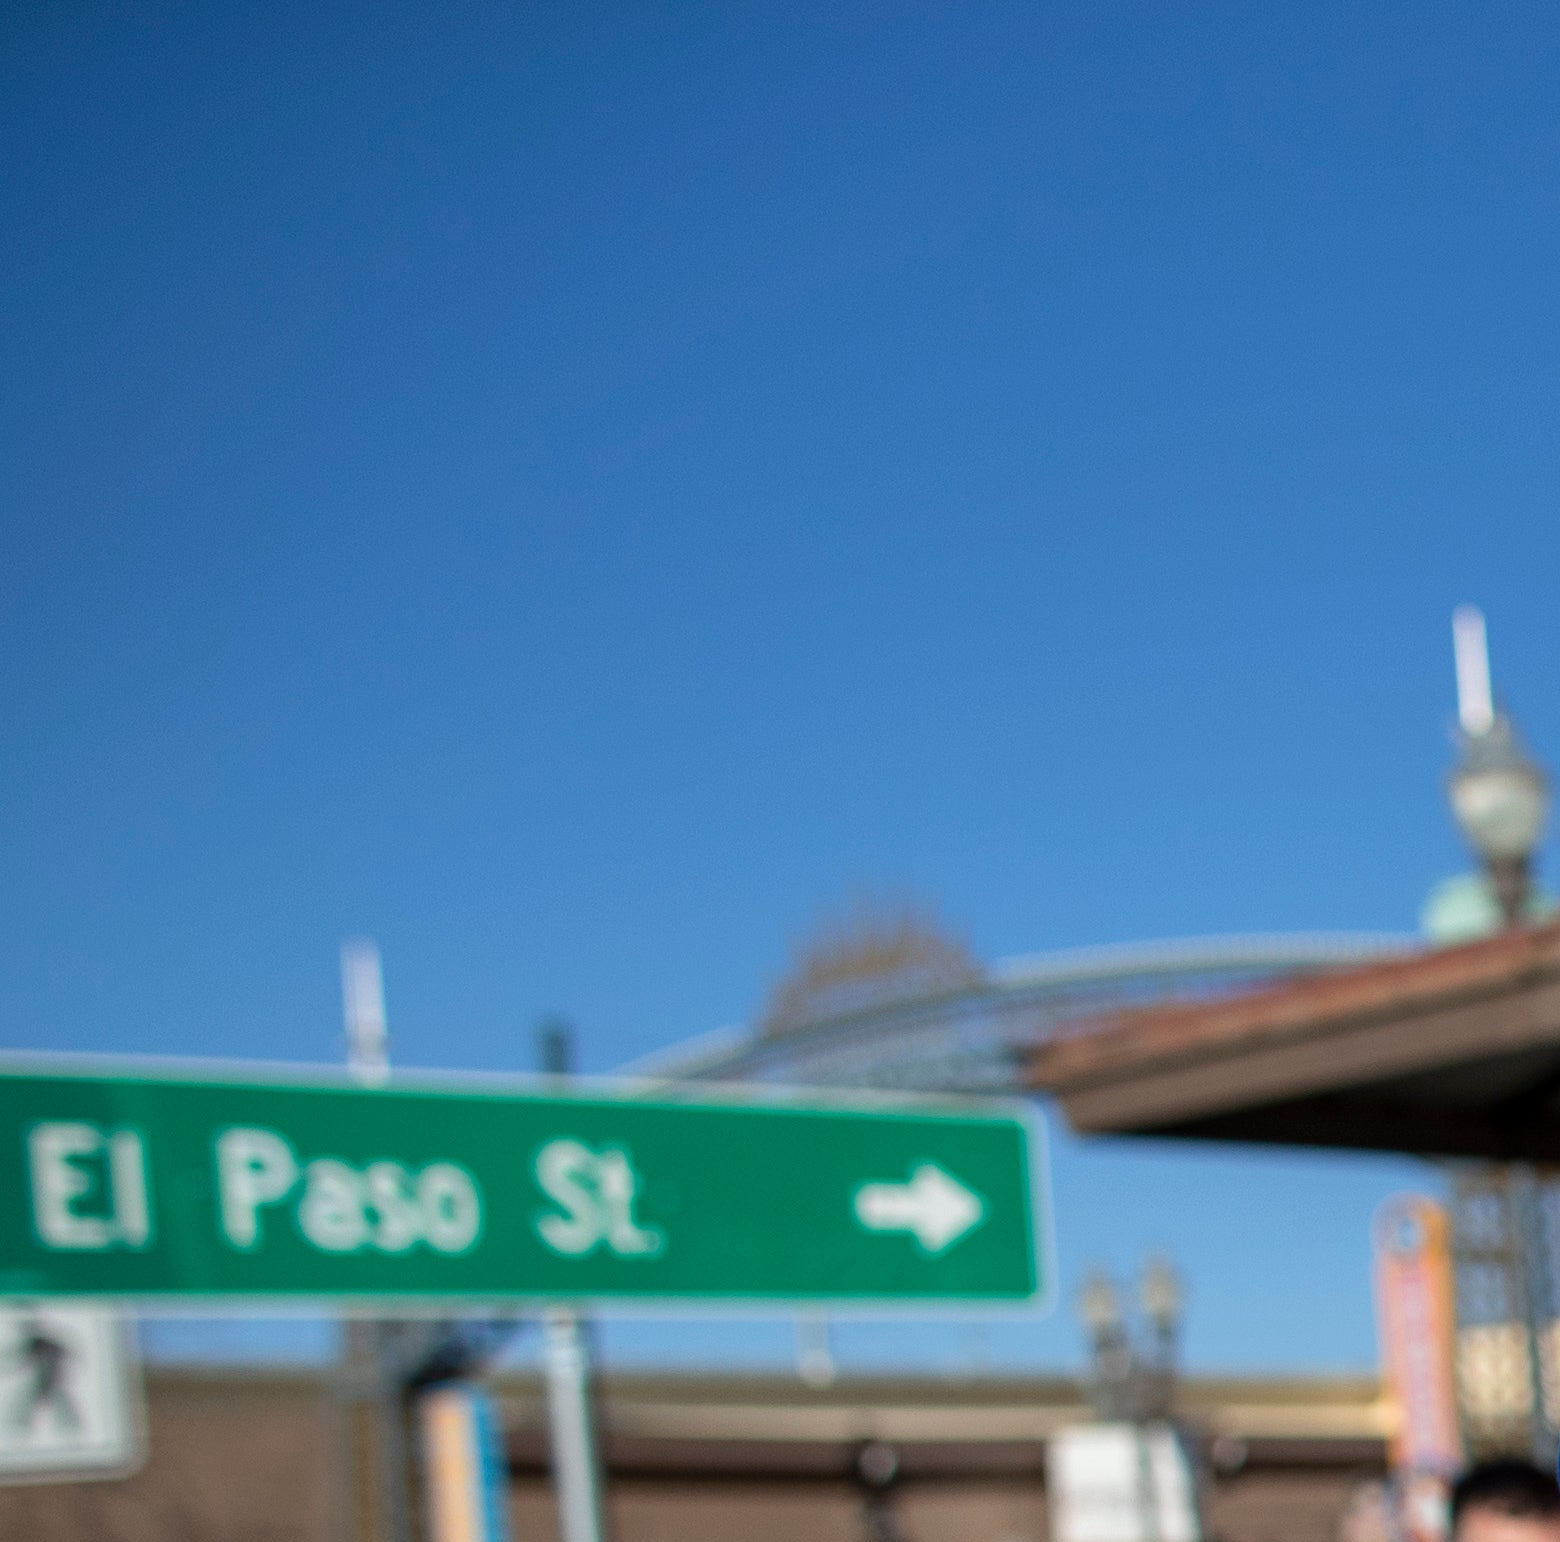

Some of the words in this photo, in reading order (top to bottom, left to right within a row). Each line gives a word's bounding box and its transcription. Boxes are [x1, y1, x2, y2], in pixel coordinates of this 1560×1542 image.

[26, 1120, 153, 1252] El
[215, 1126, 481, 1256] Paso
[533, 1138, 666, 1258] St.
